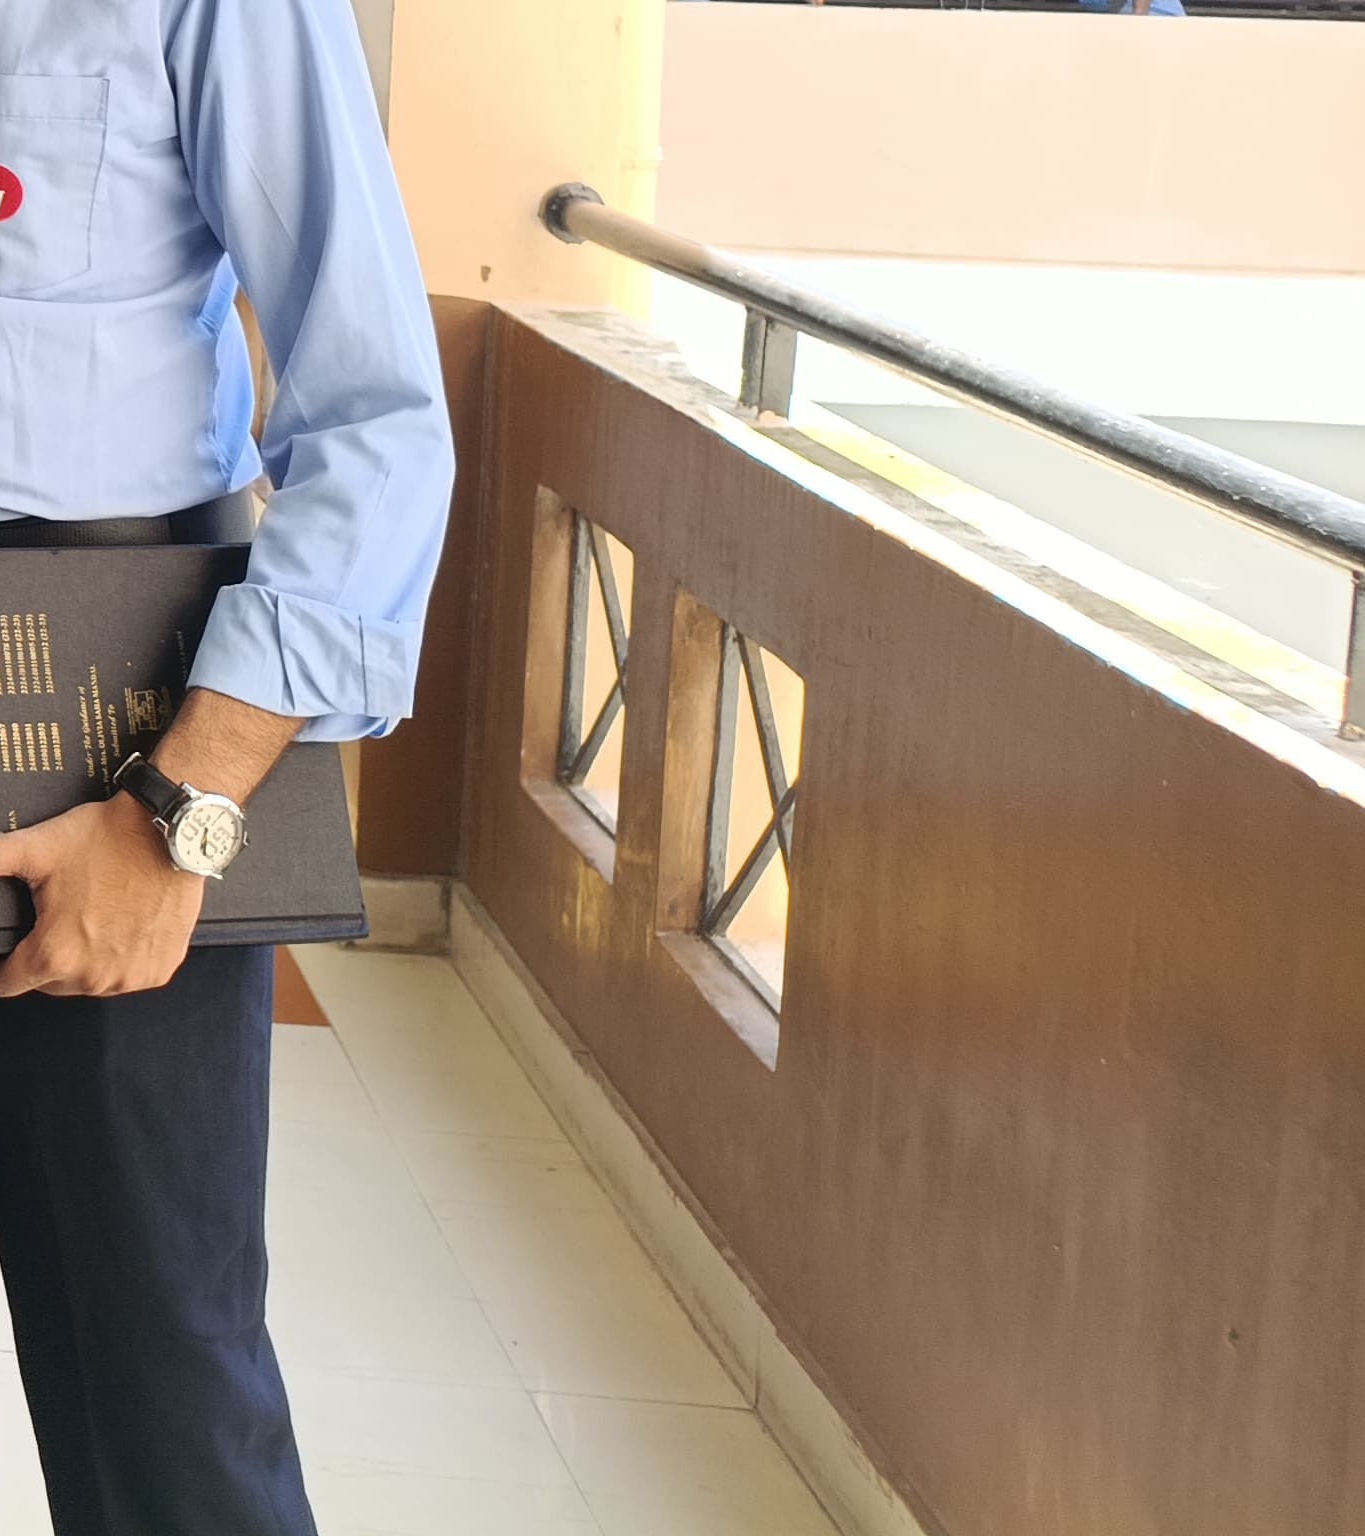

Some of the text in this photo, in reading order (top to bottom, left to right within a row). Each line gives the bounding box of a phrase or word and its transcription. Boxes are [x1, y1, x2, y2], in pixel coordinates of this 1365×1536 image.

[89, 664, 99, 697] MANDAL
[78, 686, 94, 777] Under The Guidance of
[96, 720, 105, 748] OLIVIA
[107, 716, 120, 757] Submitted
